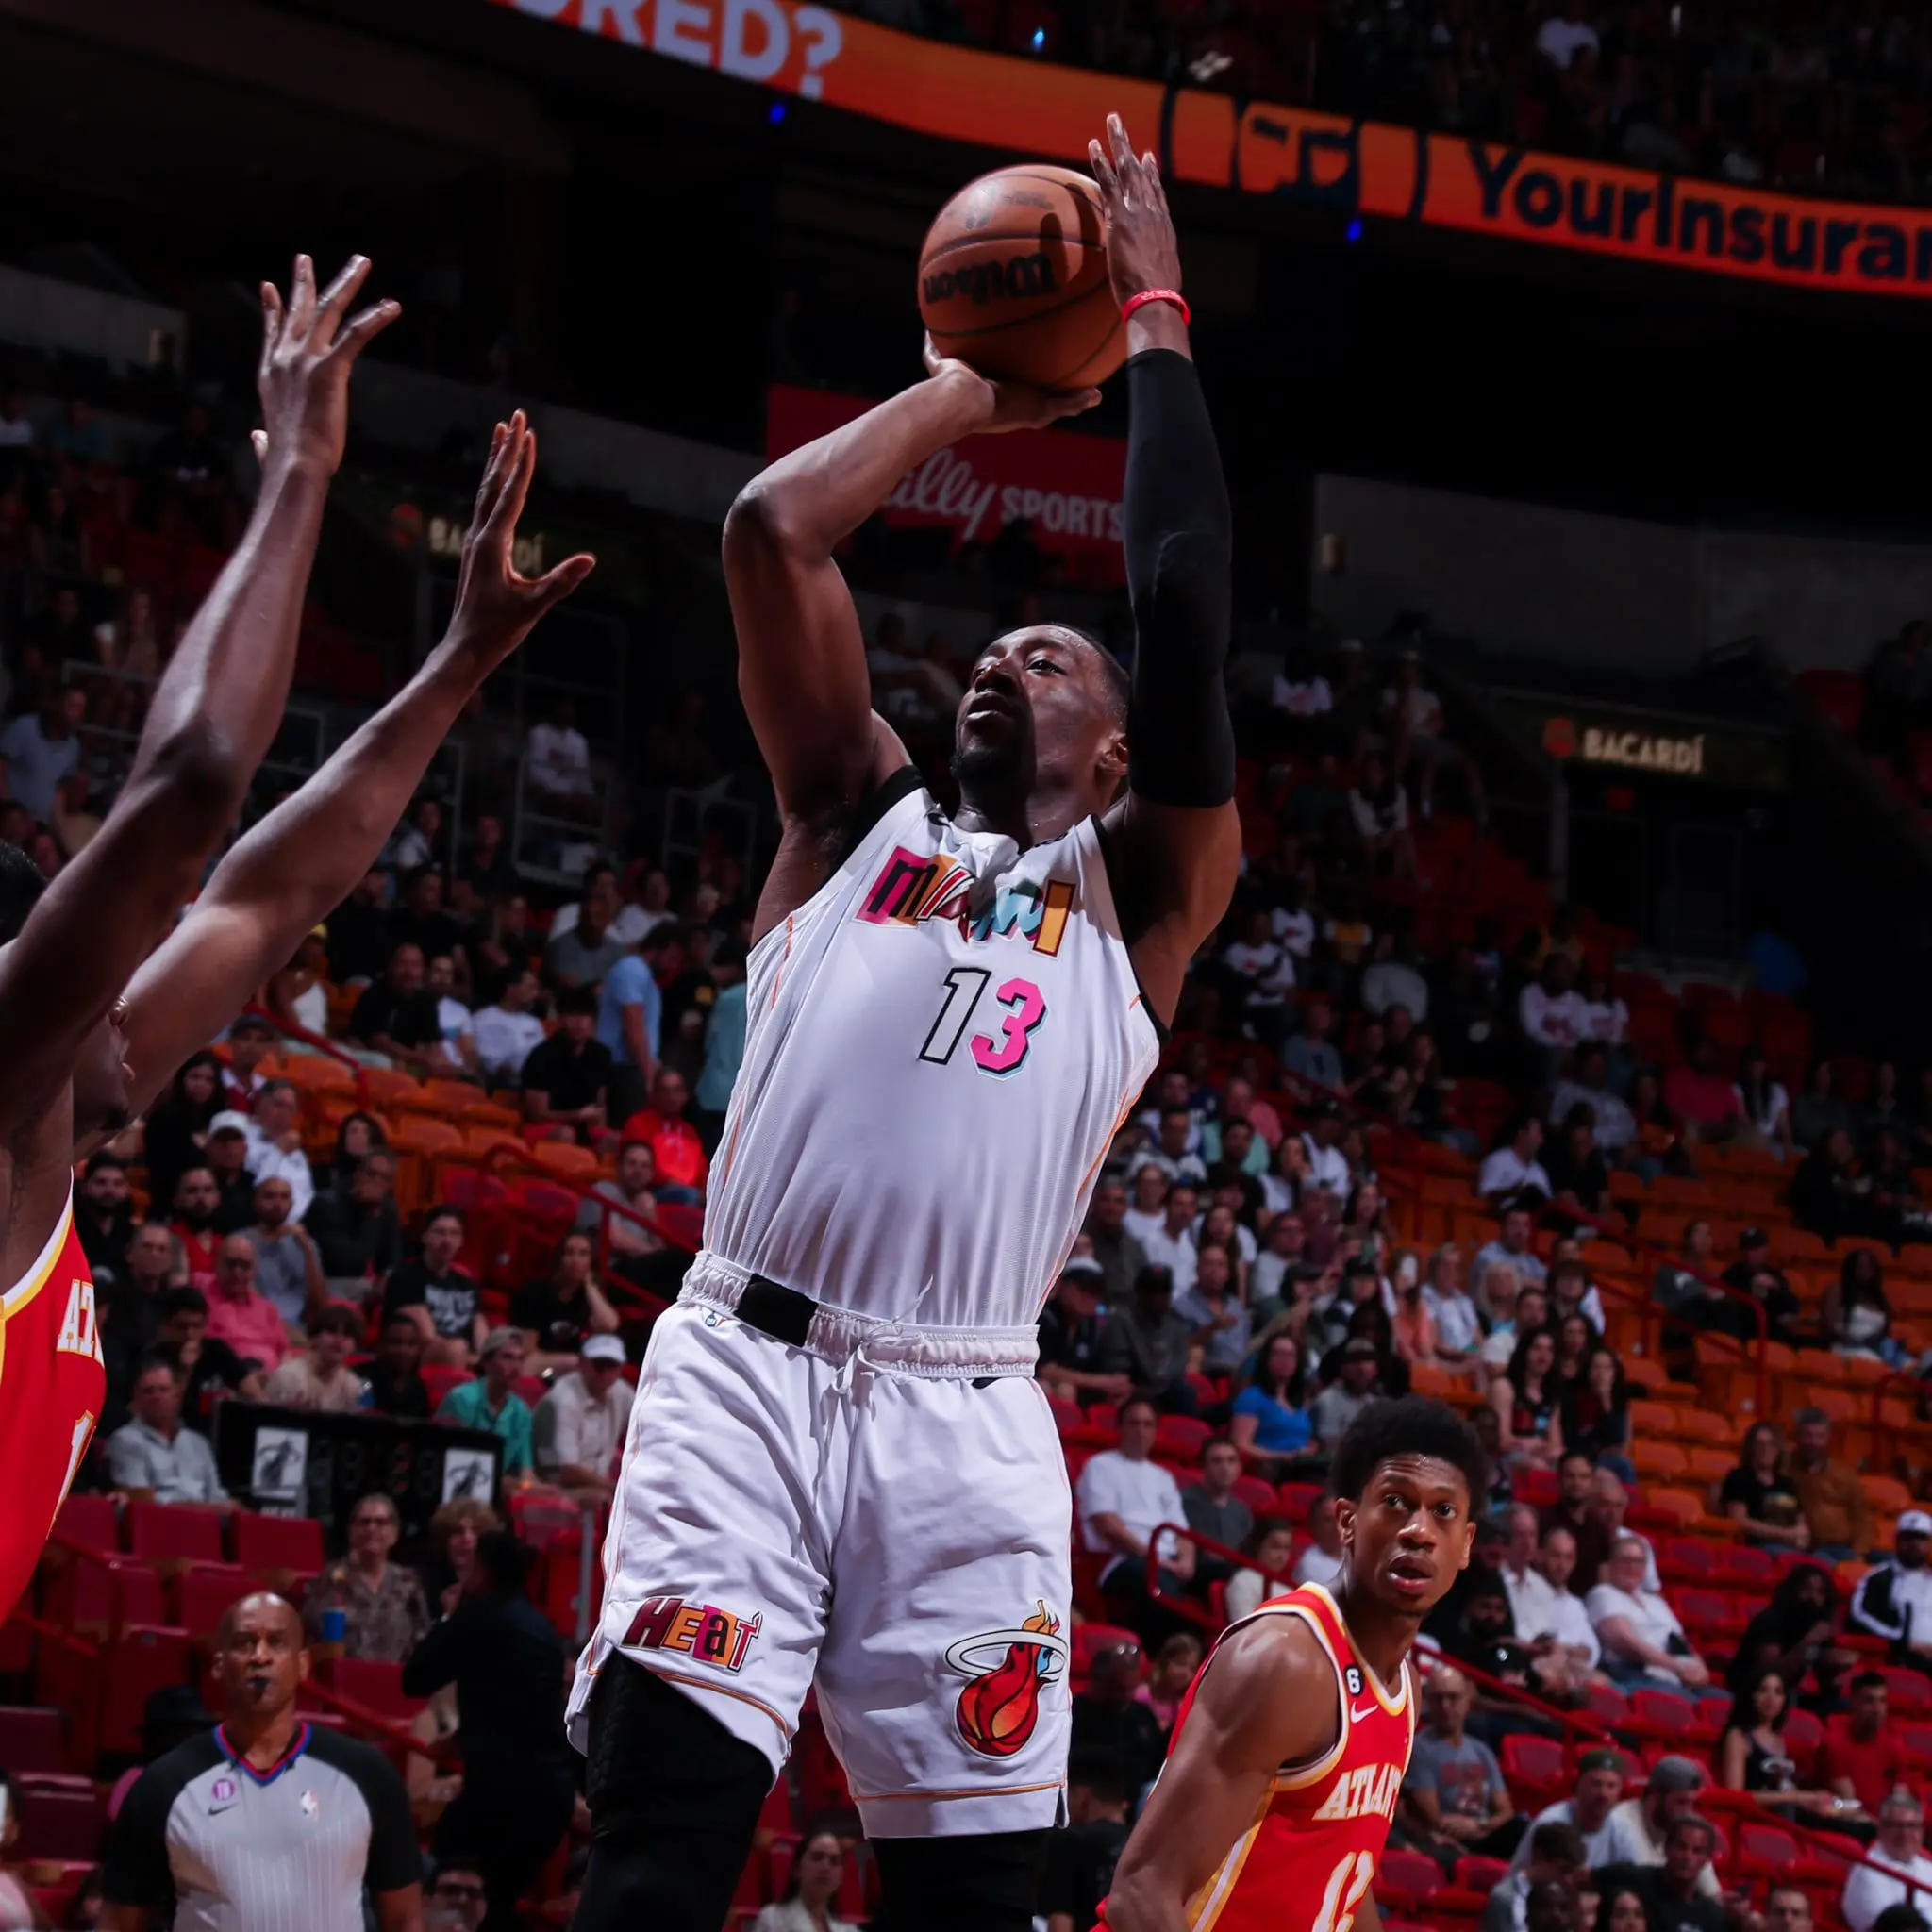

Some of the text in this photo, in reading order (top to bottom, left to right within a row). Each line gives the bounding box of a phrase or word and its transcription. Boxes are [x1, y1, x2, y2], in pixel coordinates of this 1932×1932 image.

[1000, 484, 1125, 541] SPORTS
[918, 967, 1048, 1081] 13
[1346, 1668, 1361, 1694] 6
